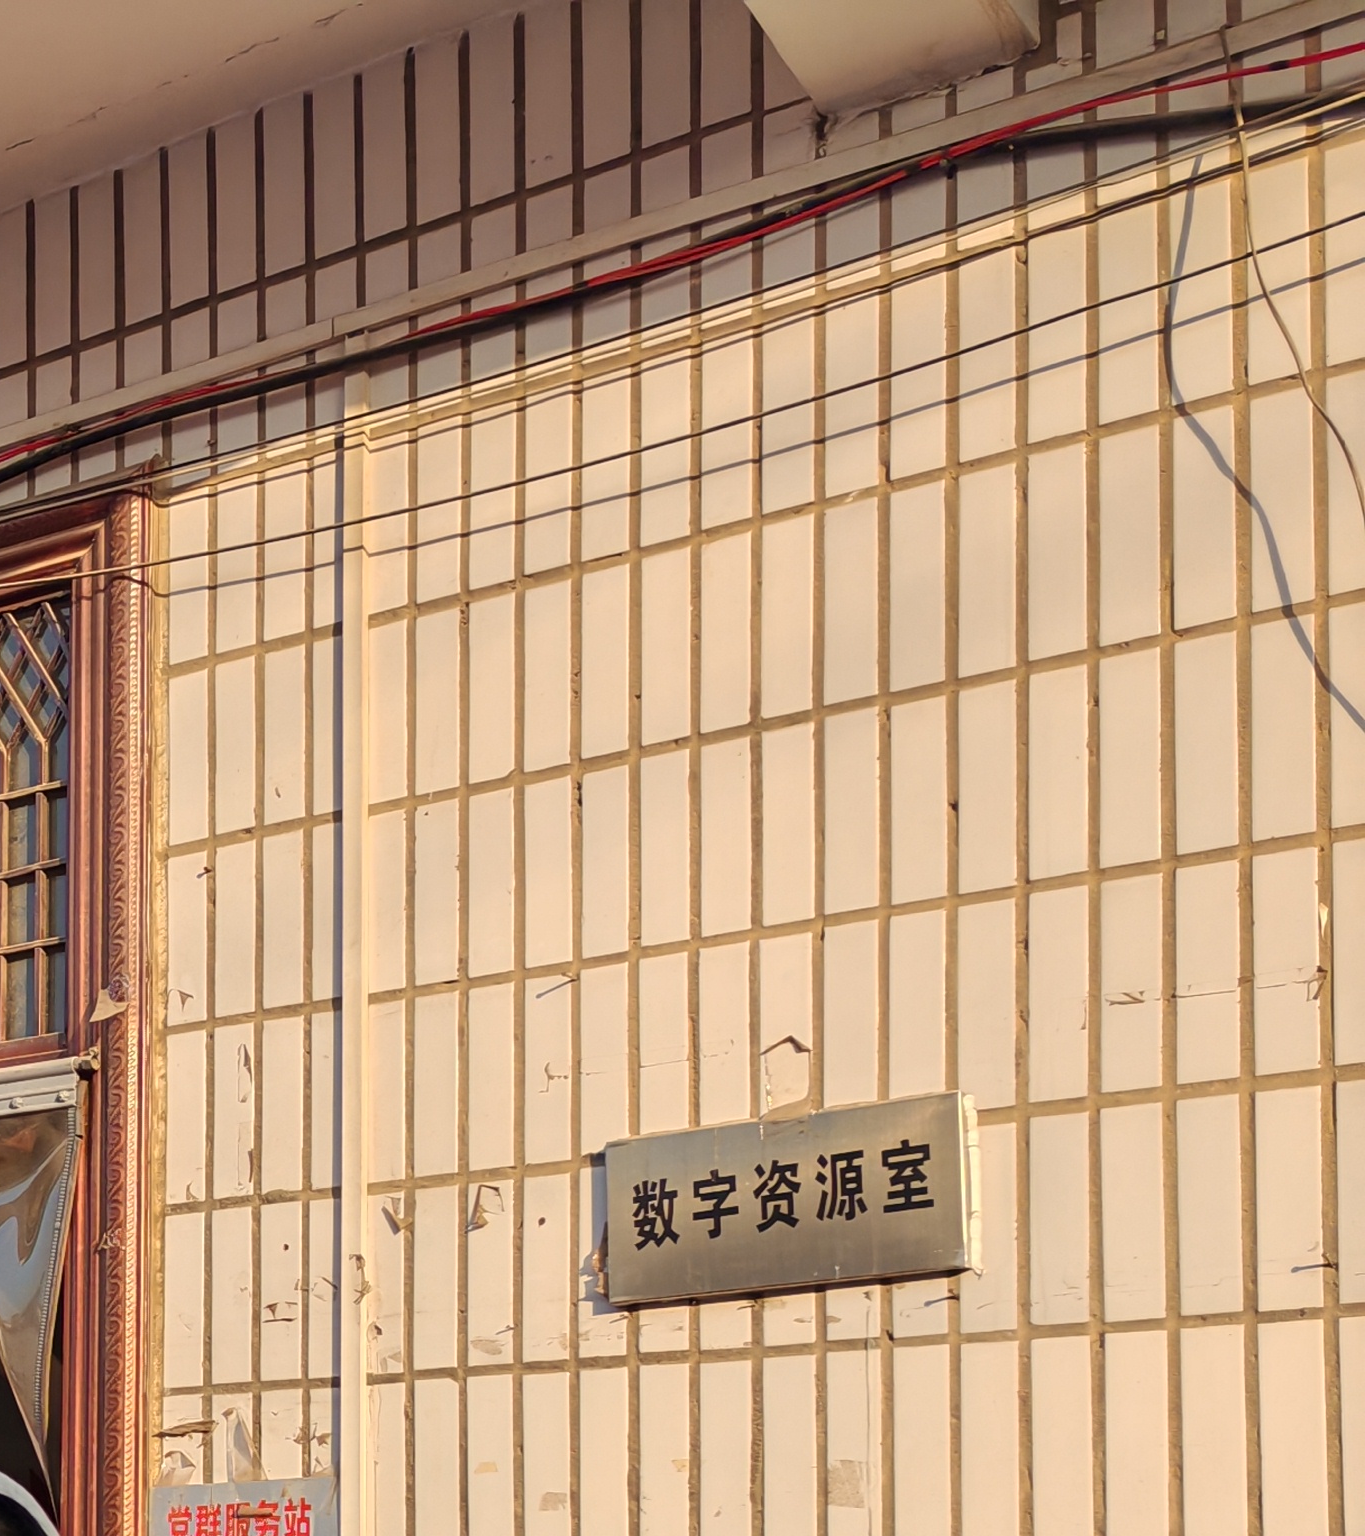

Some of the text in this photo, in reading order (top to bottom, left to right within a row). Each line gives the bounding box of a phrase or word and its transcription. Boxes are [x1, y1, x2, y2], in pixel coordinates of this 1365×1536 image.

[632, 1139, 935, 1251] 数字资源室
